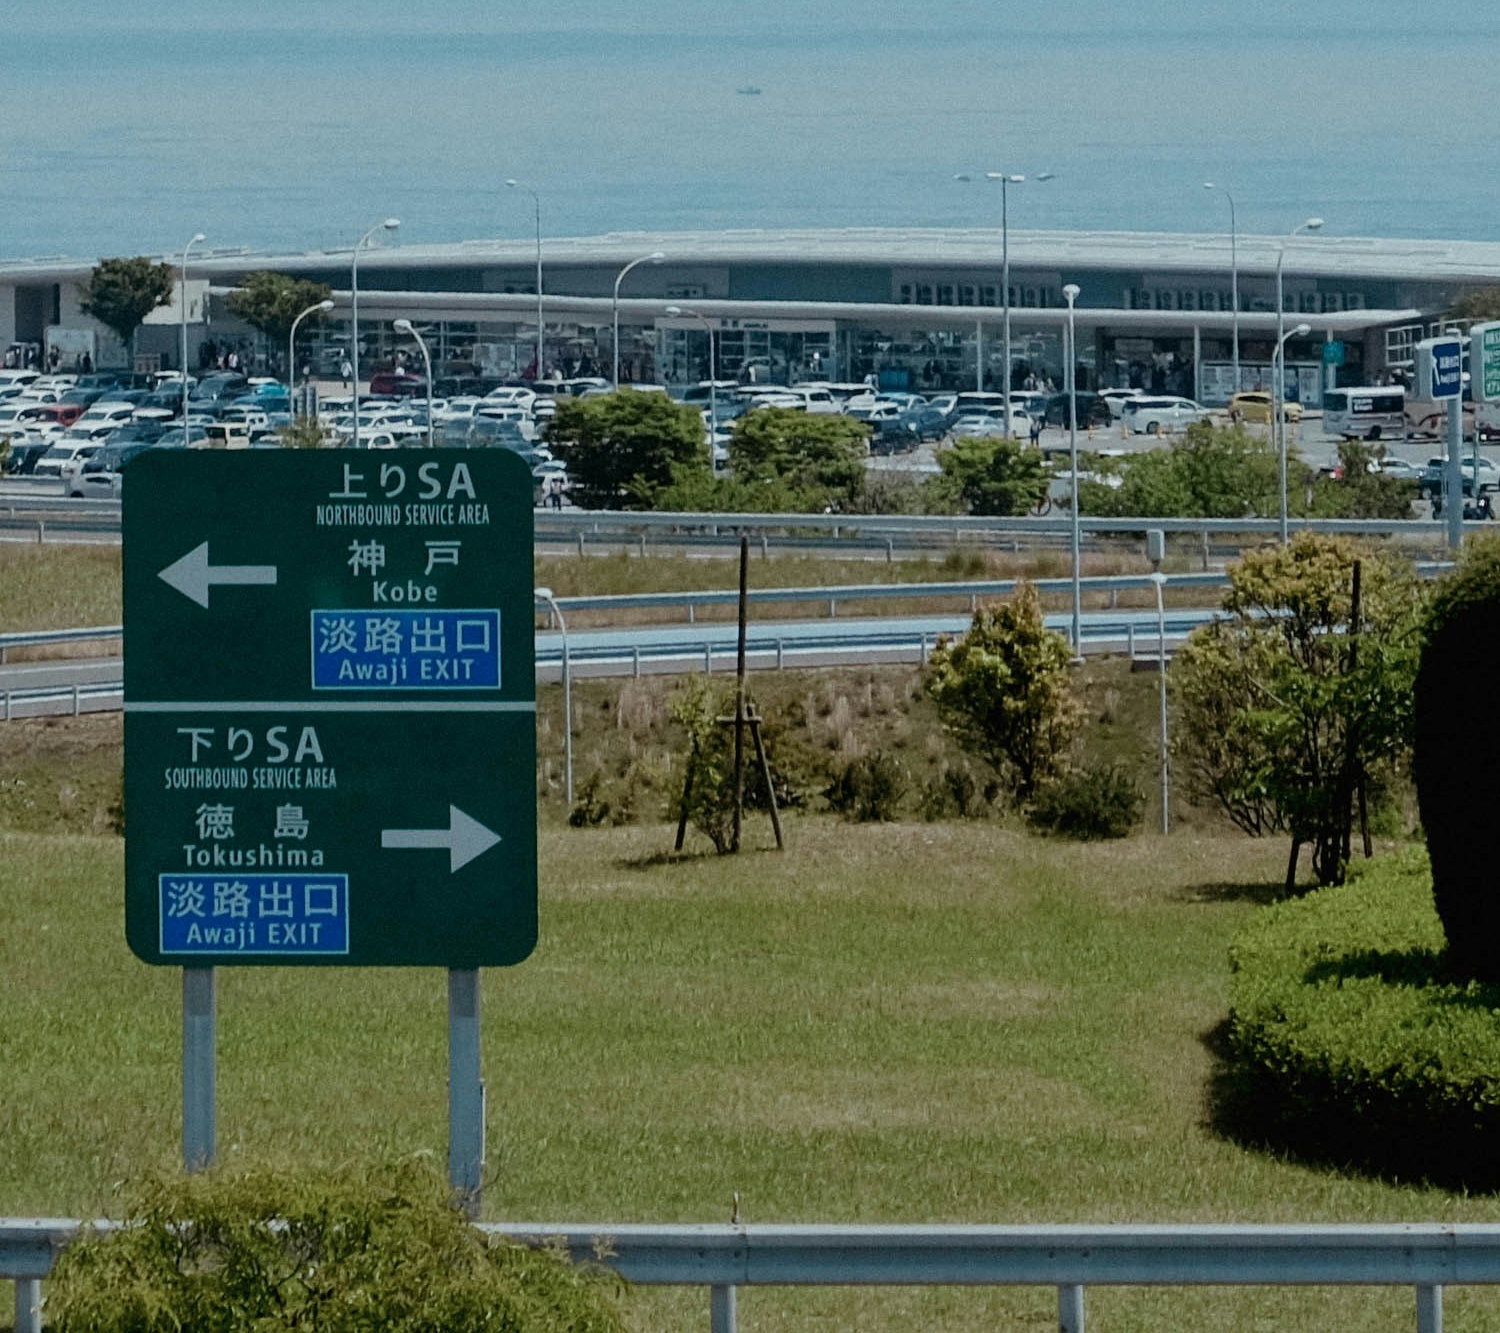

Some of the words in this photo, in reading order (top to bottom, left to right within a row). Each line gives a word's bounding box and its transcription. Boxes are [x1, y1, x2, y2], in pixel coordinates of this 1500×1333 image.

[328, 462, 477, 500] 上りSA
[316, 504, 401, 526] NORTHBOUND
[405, 503, 455, 526] SERVICE
[458, 503, 490, 525] AREA
[373, 579, 438, 603] Kobe
[319, 617, 490, 655] 淡路出口
[338, 657, 407, 684] Awaji
[420, 658, 474, 680] EXIT
[176, 725, 324, 763] 下りSA
[164, 767, 248, 790] SOUTHBOUND
[252, 767, 301, 790] SERVICE
[305, 767, 337, 789] AREA
[182, 843, 324, 867] Tokushima
[167, 880, 338, 919] 淡路出口
[186, 921, 255, 949] Awaji
[268, 922, 322, 945] EXIT
